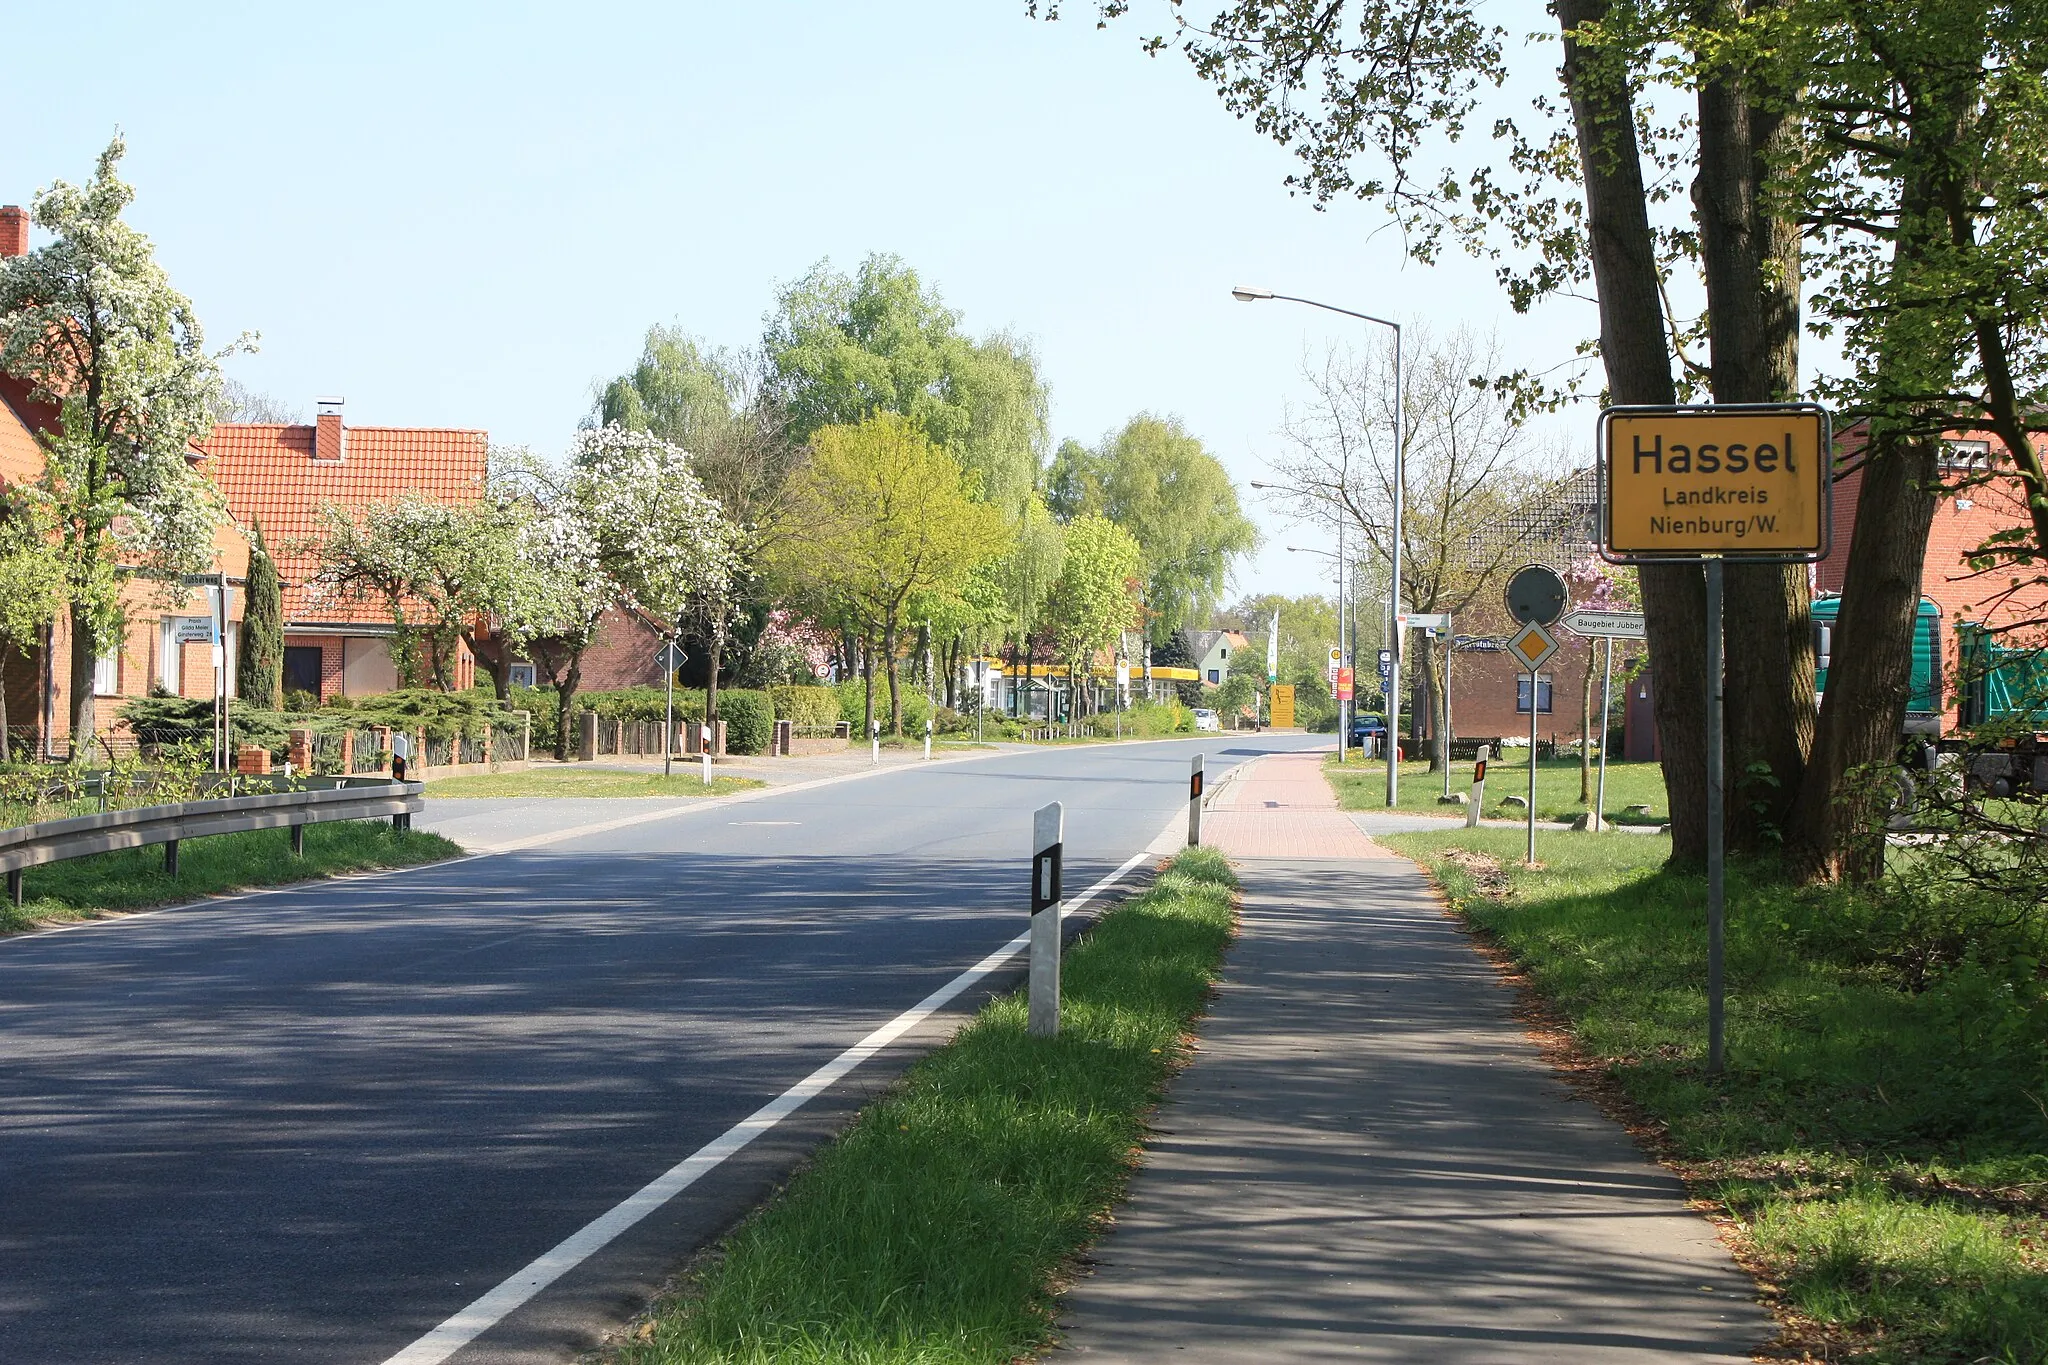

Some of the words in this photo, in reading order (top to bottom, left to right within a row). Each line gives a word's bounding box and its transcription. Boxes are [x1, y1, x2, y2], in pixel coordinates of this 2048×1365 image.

[1632, 432, 1797, 475] Hassel
[1662, 486, 1769, 506] Landkreis
[1649, 514, 1780, 538] Nienburg/W.
[1577, 619, 1615, 629] Baugebiet
[1616, 621, 1643, 630] Jübber
